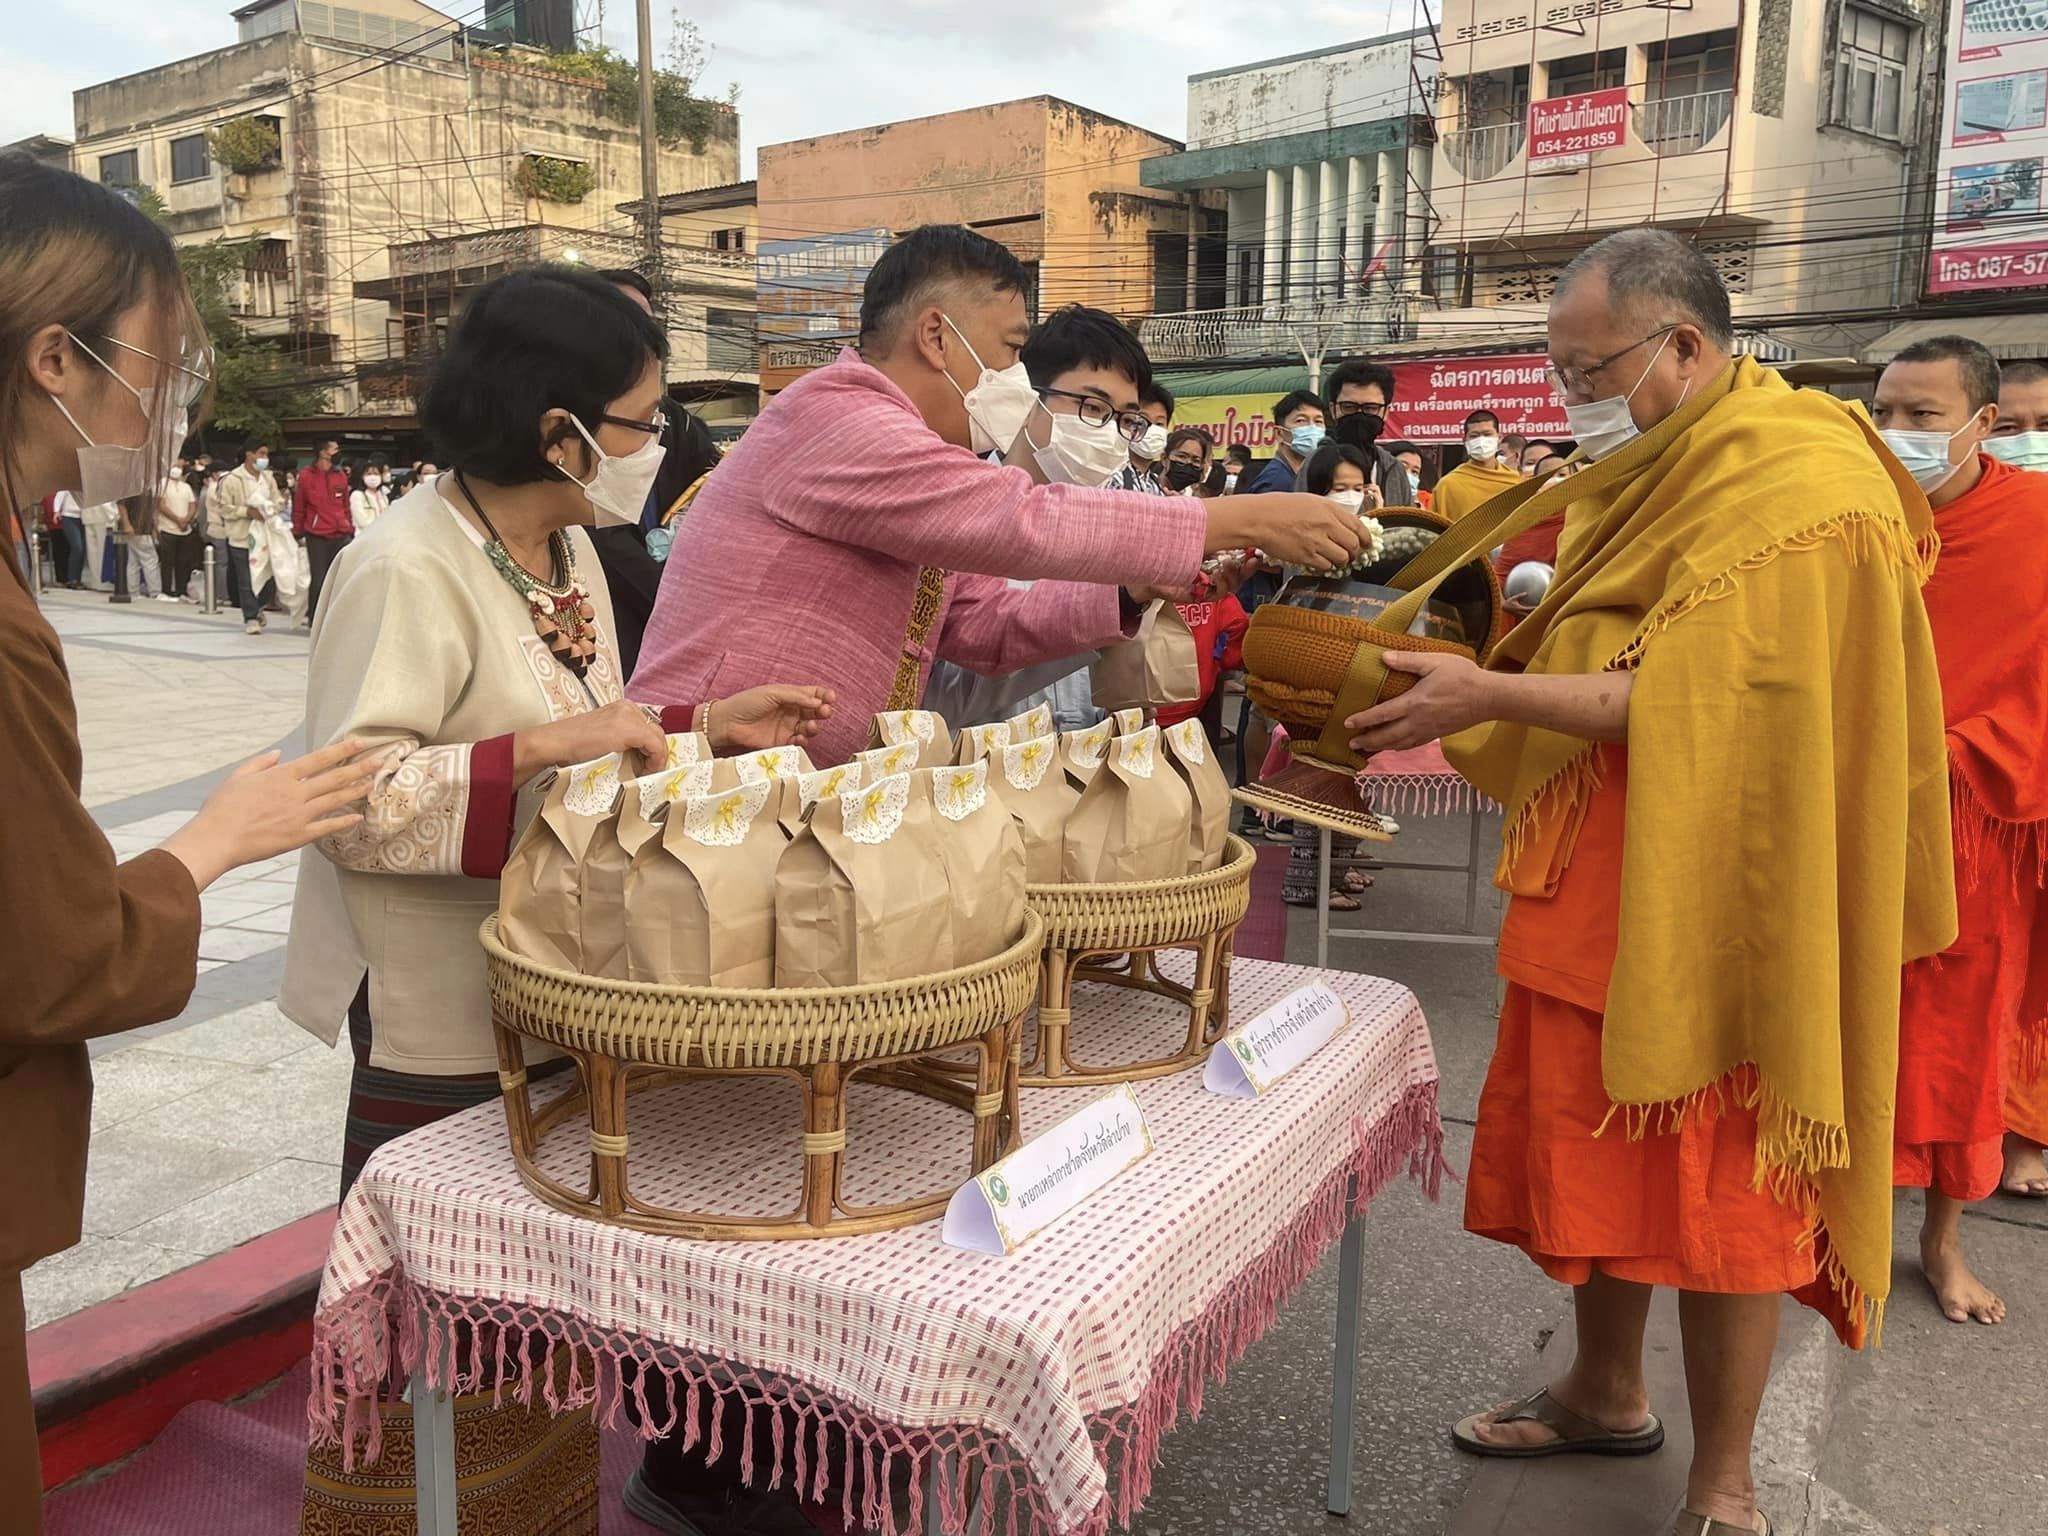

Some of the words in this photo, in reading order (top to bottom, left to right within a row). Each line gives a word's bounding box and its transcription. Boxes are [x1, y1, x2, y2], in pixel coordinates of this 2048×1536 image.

[1536, 130, 1616, 154] 054-221859
[1017, 1113, 1132, 1209] นายกเหล่ากาชาดจังหวัดลำปาง
